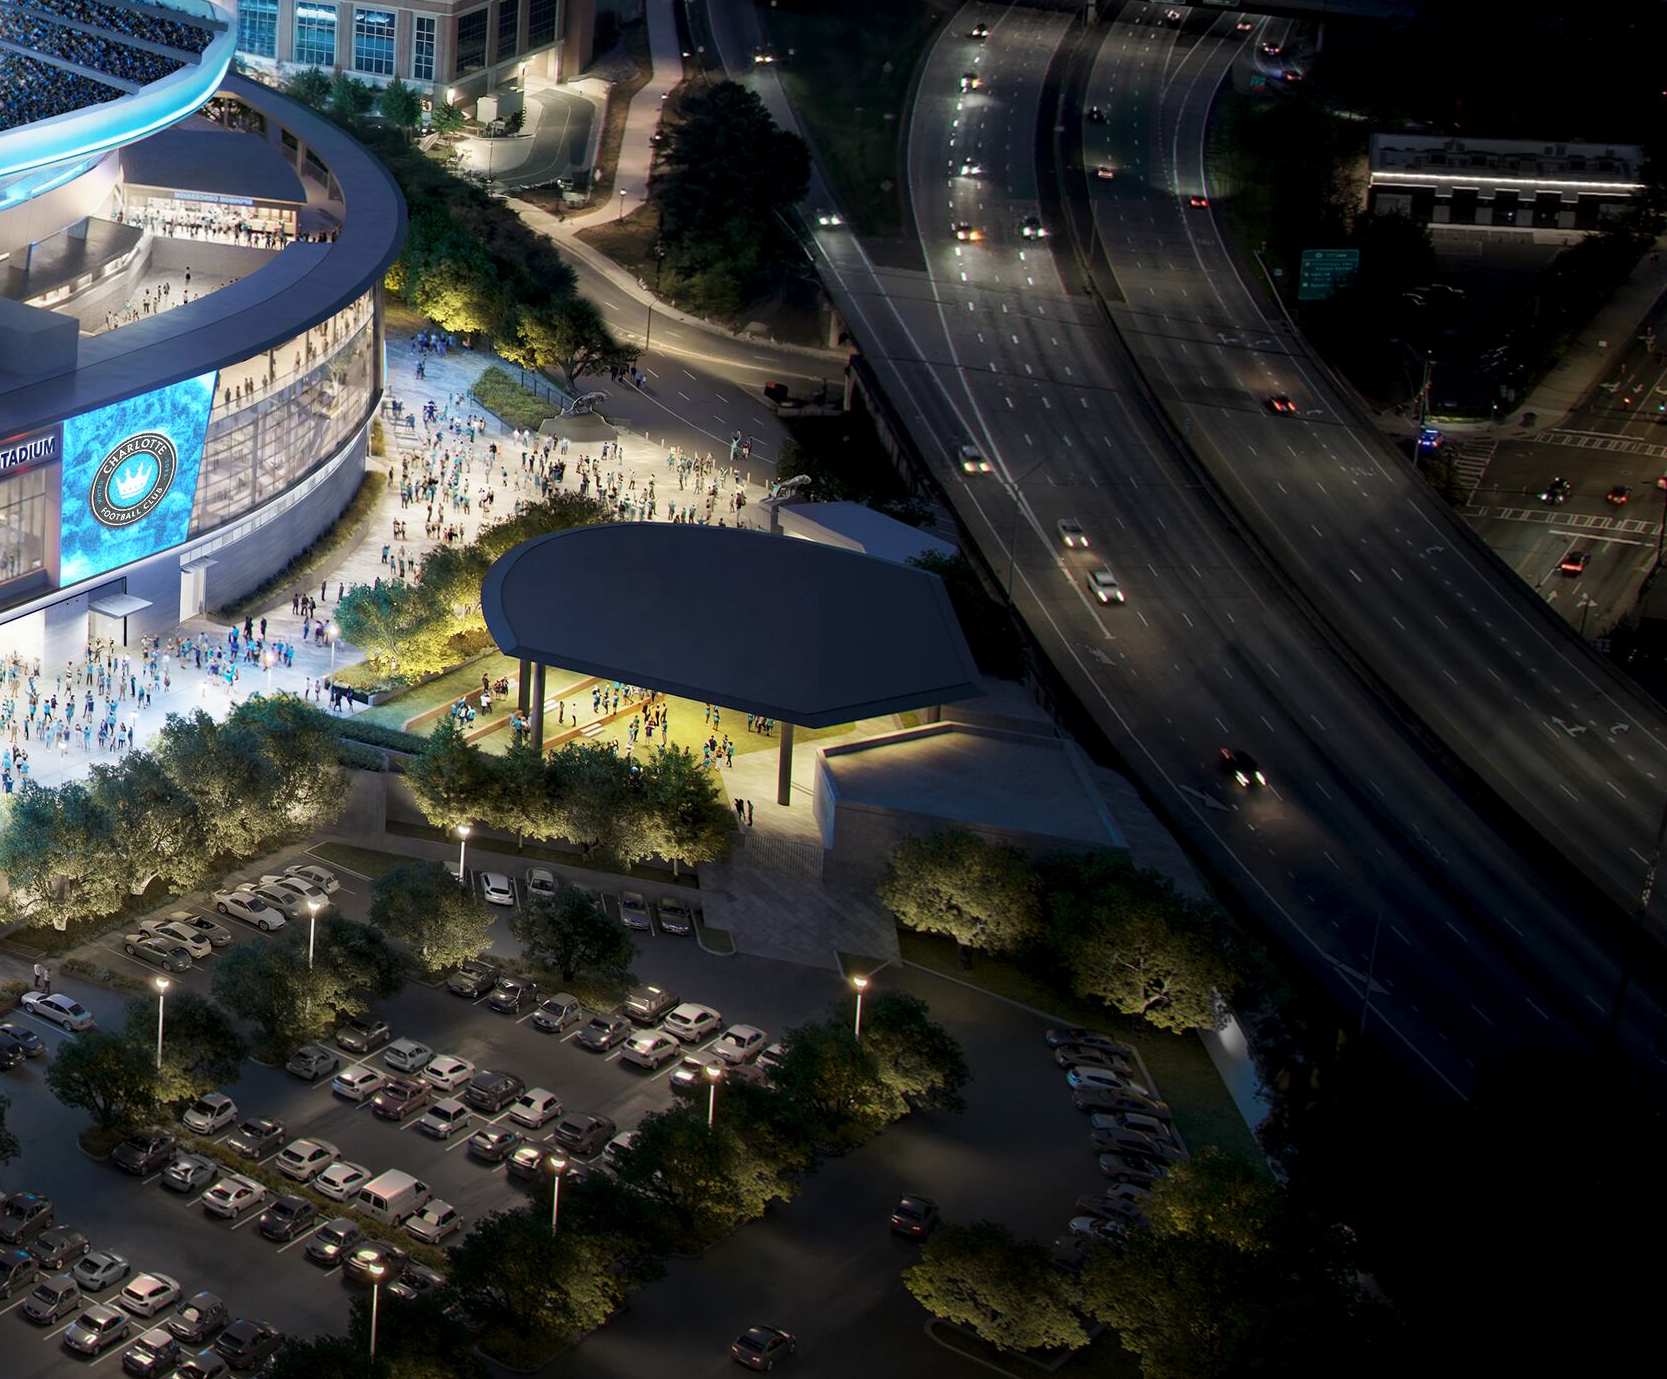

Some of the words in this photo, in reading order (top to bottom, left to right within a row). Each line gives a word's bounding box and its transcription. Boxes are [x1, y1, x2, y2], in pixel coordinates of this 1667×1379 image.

[103, 438, 167, 474] CHARLOTTE
[100, 506, 142, 521] FOOTBALL
[143, 487, 163, 509] CLUB
